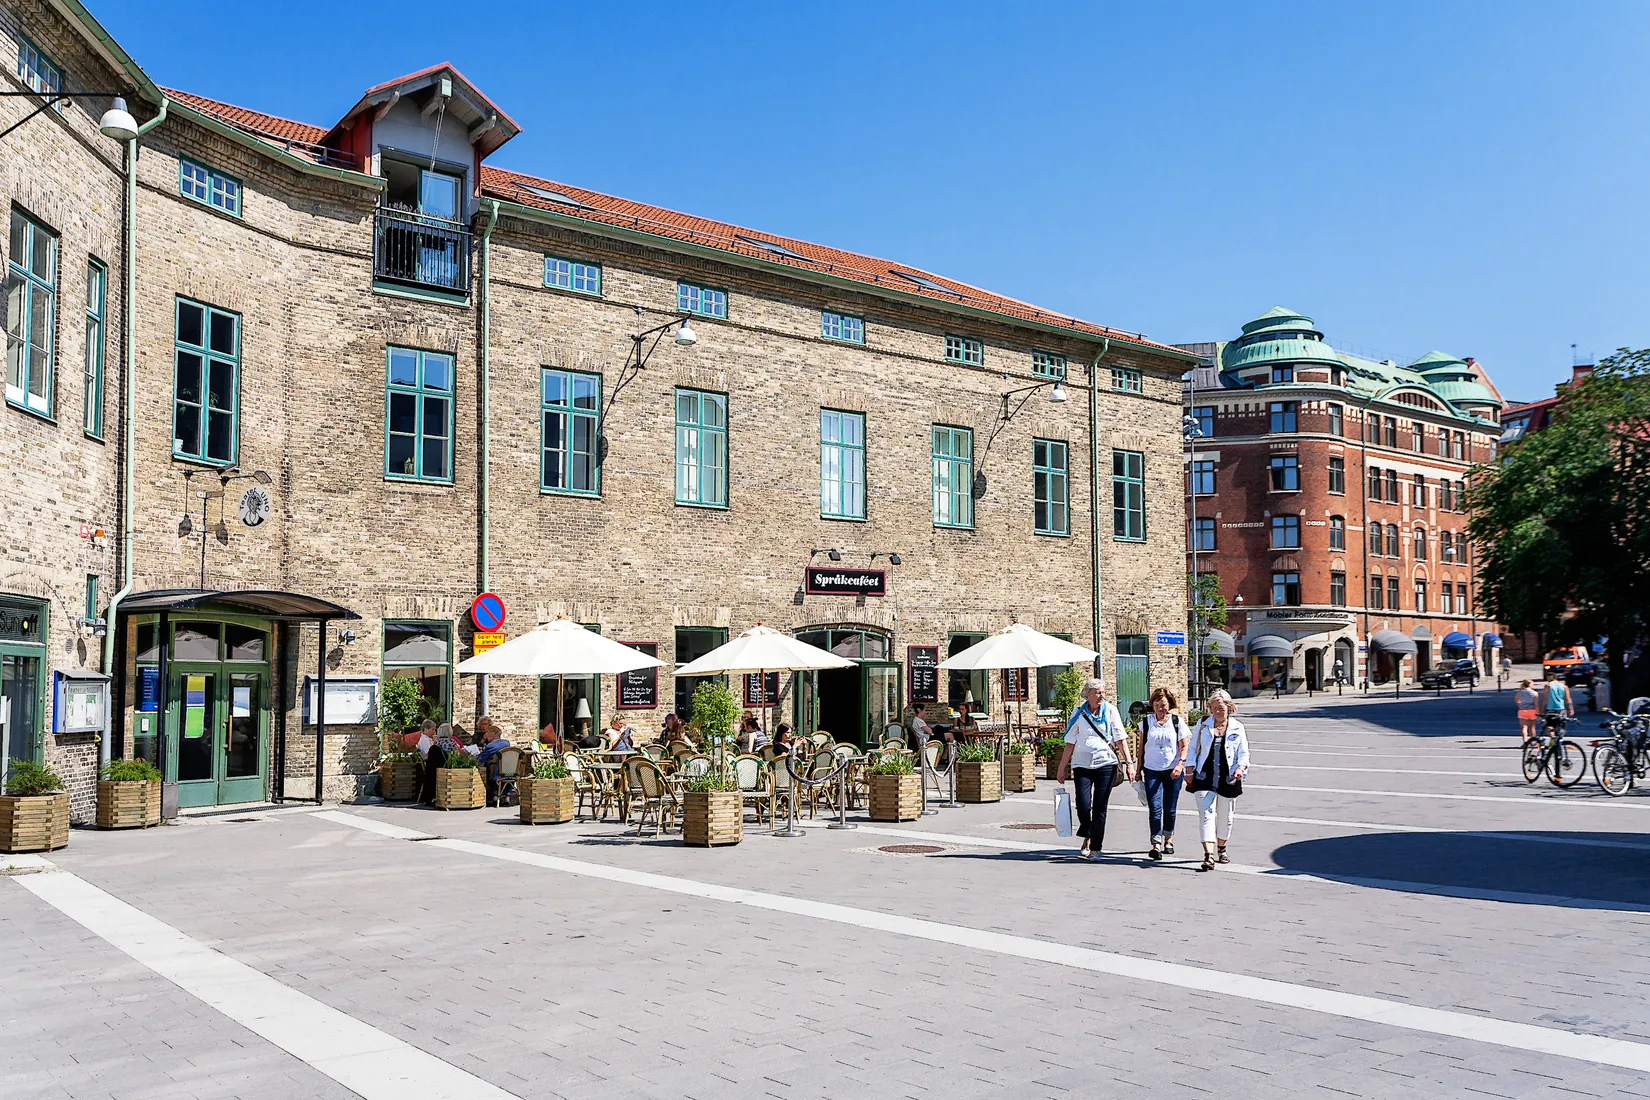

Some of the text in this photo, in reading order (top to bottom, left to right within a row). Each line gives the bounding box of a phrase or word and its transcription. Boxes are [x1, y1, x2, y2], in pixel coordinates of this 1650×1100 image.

[240, 487, 270, 512] Teater UNO
[815, 573, 879, 587] Språkcaféet
